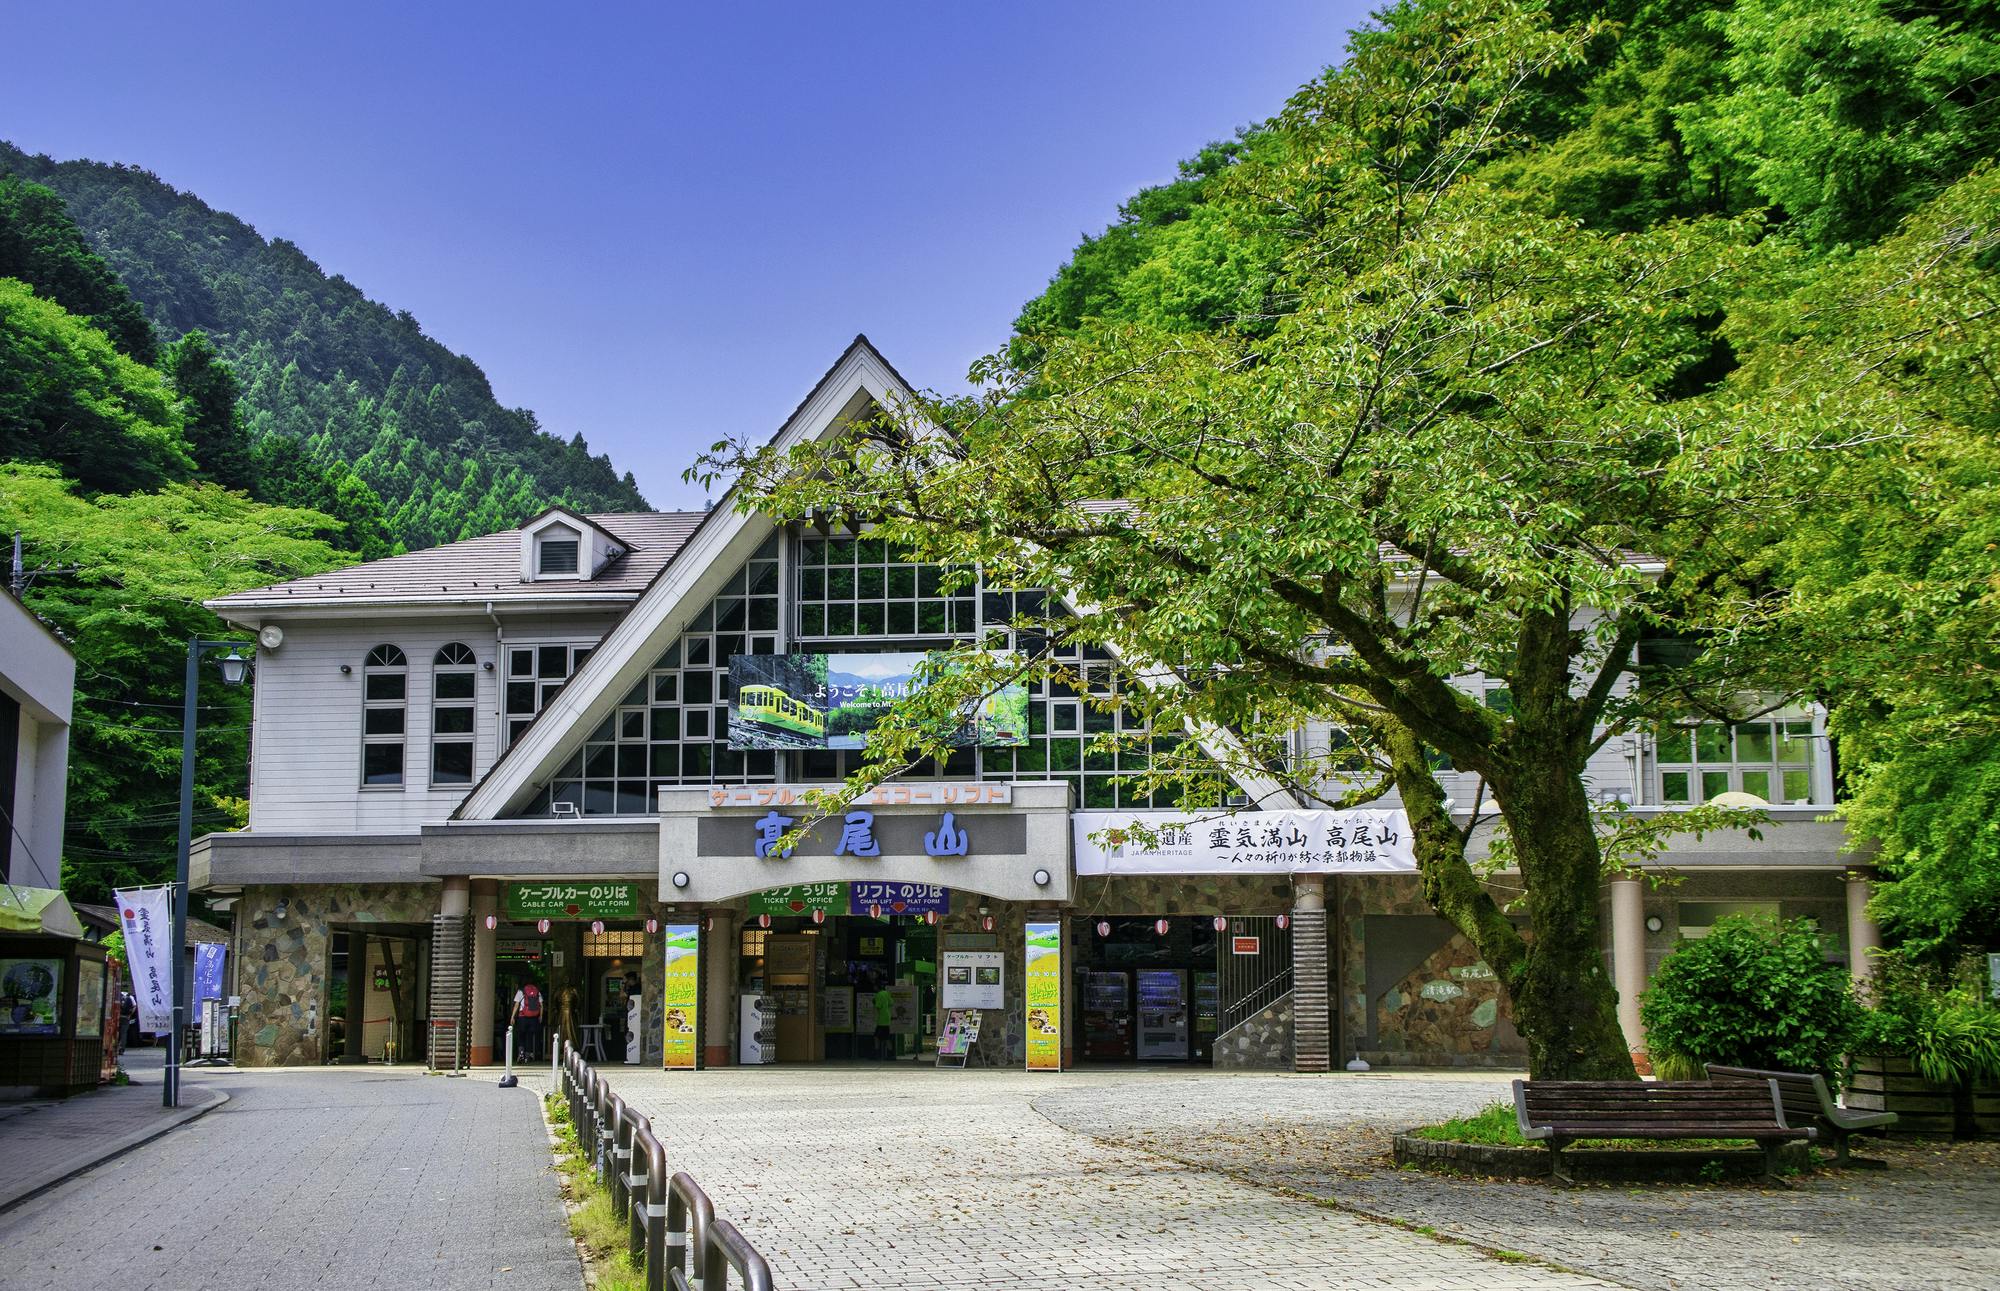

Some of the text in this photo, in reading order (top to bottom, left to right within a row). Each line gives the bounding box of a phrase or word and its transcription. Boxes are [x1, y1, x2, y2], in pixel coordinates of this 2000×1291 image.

[839, 701, 872, 709] Welcome
[711, 787, 1004, 806] ケーブル エコー リフト
[754, 811, 968, 859] 高尾山
[1130, 828, 1193, 847] 遺産
[1208, 825, 1399, 849] 霊気満山 高尾山
[1131, 849, 1193, 857] JAPAN HERITAGE
[518, 886, 629, 900] ケーブルカーのりば
[802, 884, 839, 896] うりば
[856, 884, 944, 898] リフト のりば
[1460, 968, 1494, 979] 高尾山
